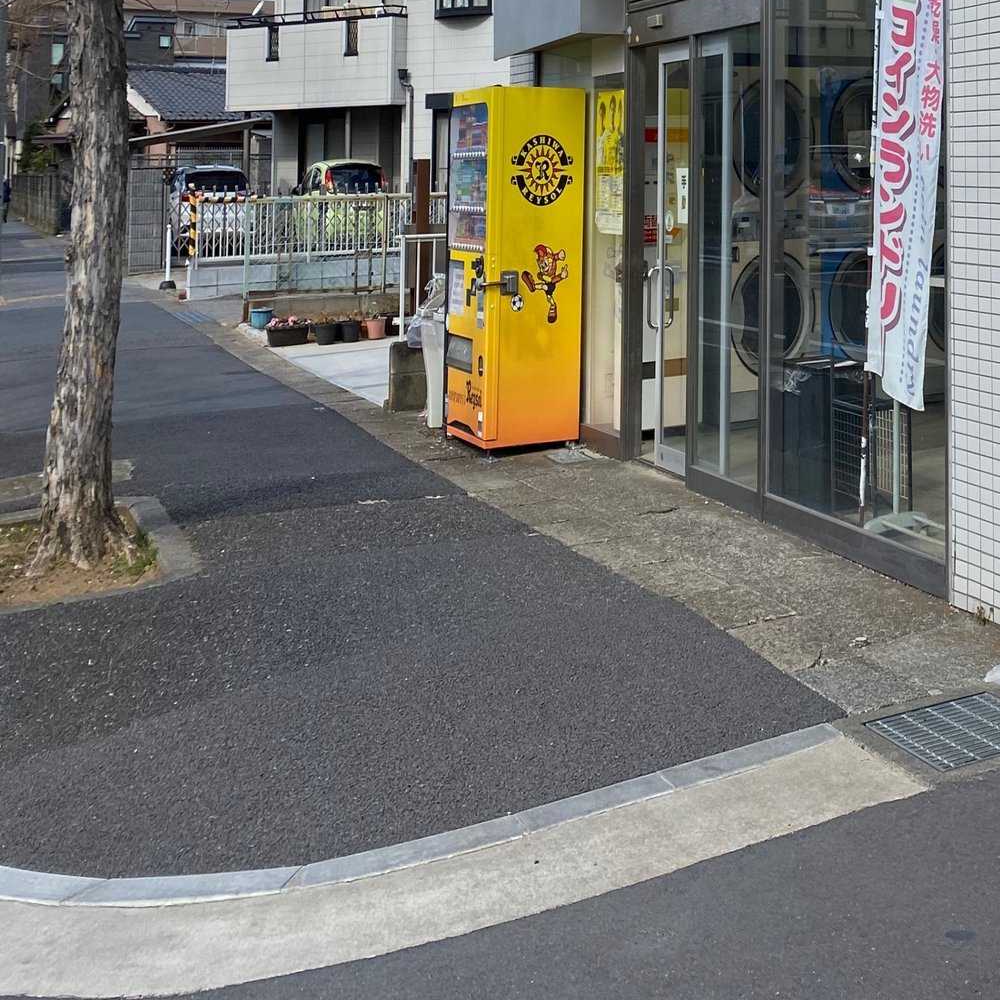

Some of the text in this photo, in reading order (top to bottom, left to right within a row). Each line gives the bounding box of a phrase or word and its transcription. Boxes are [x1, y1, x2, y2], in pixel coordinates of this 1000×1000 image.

[520, 136, 564, 158] KASHIWA
[521, 187, 563, 205] REYSOL
[905, 257, 929, 396] laundry
